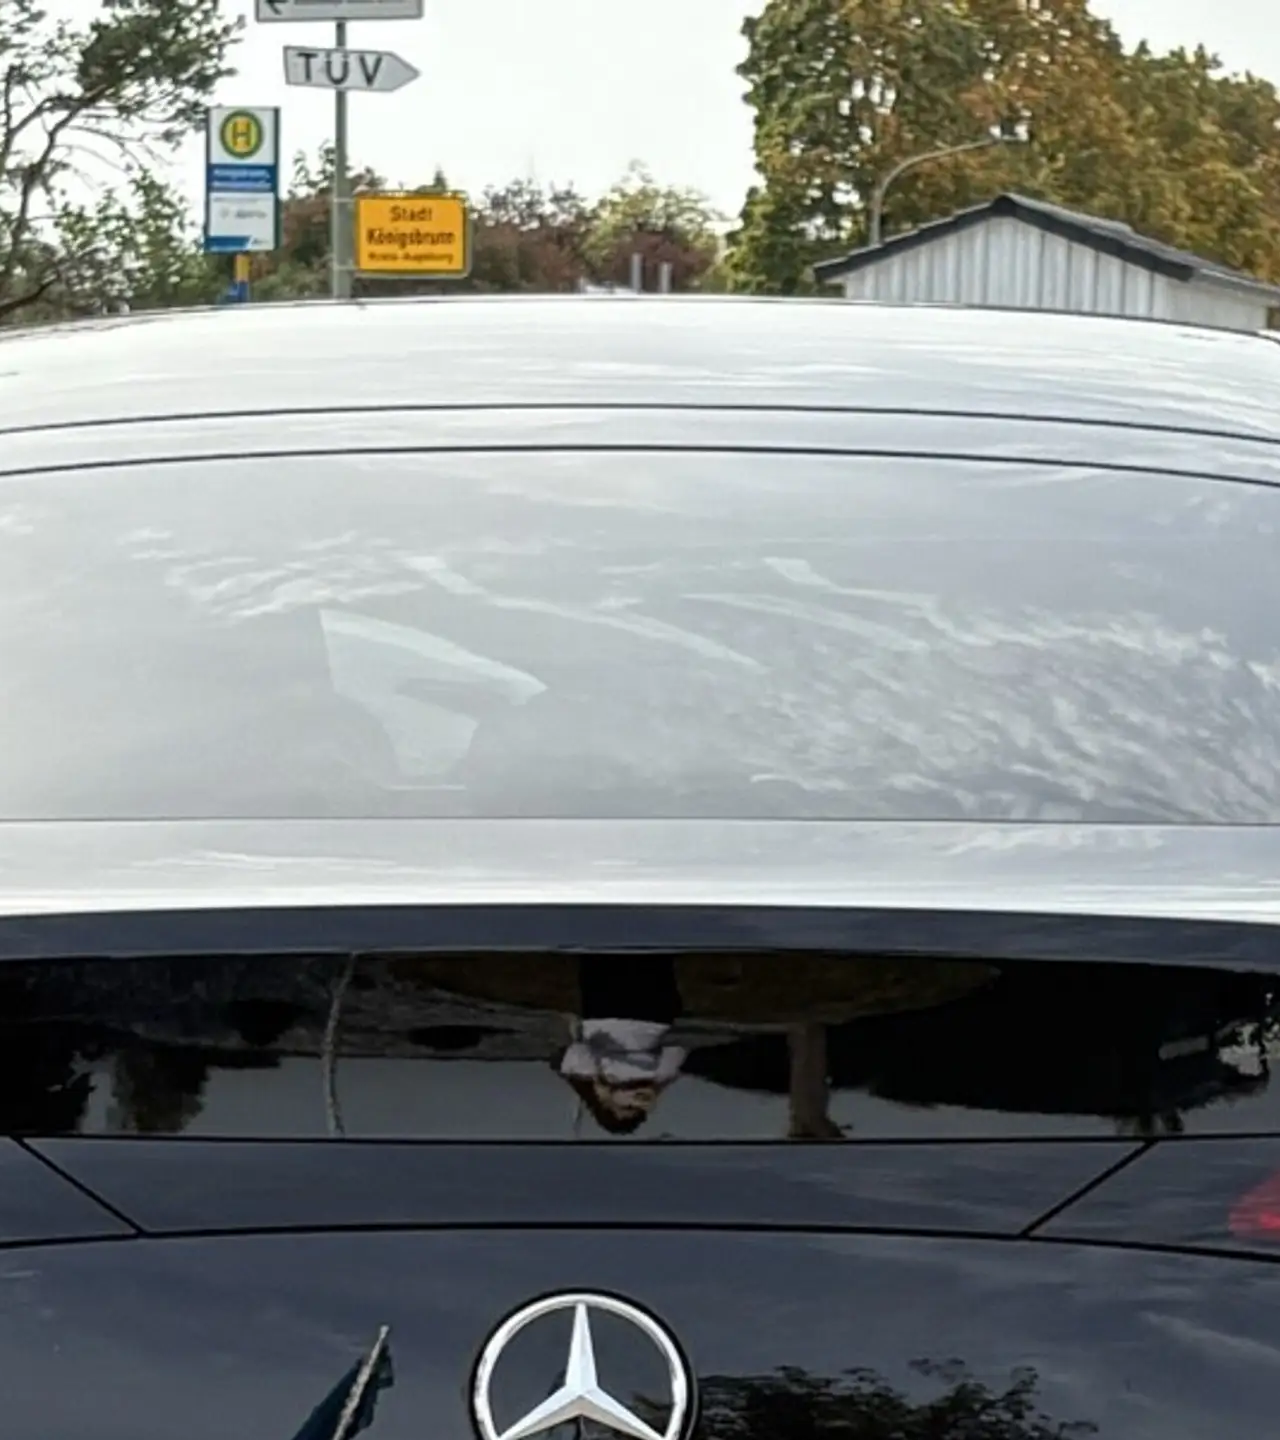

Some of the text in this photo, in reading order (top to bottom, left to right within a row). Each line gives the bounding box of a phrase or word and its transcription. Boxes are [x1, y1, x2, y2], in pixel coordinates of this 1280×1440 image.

[296, 52, 382, 87] TÜV
[388, 204, 433, 222] Stadt
[366, 227, 455, 250] Königsbrunn
